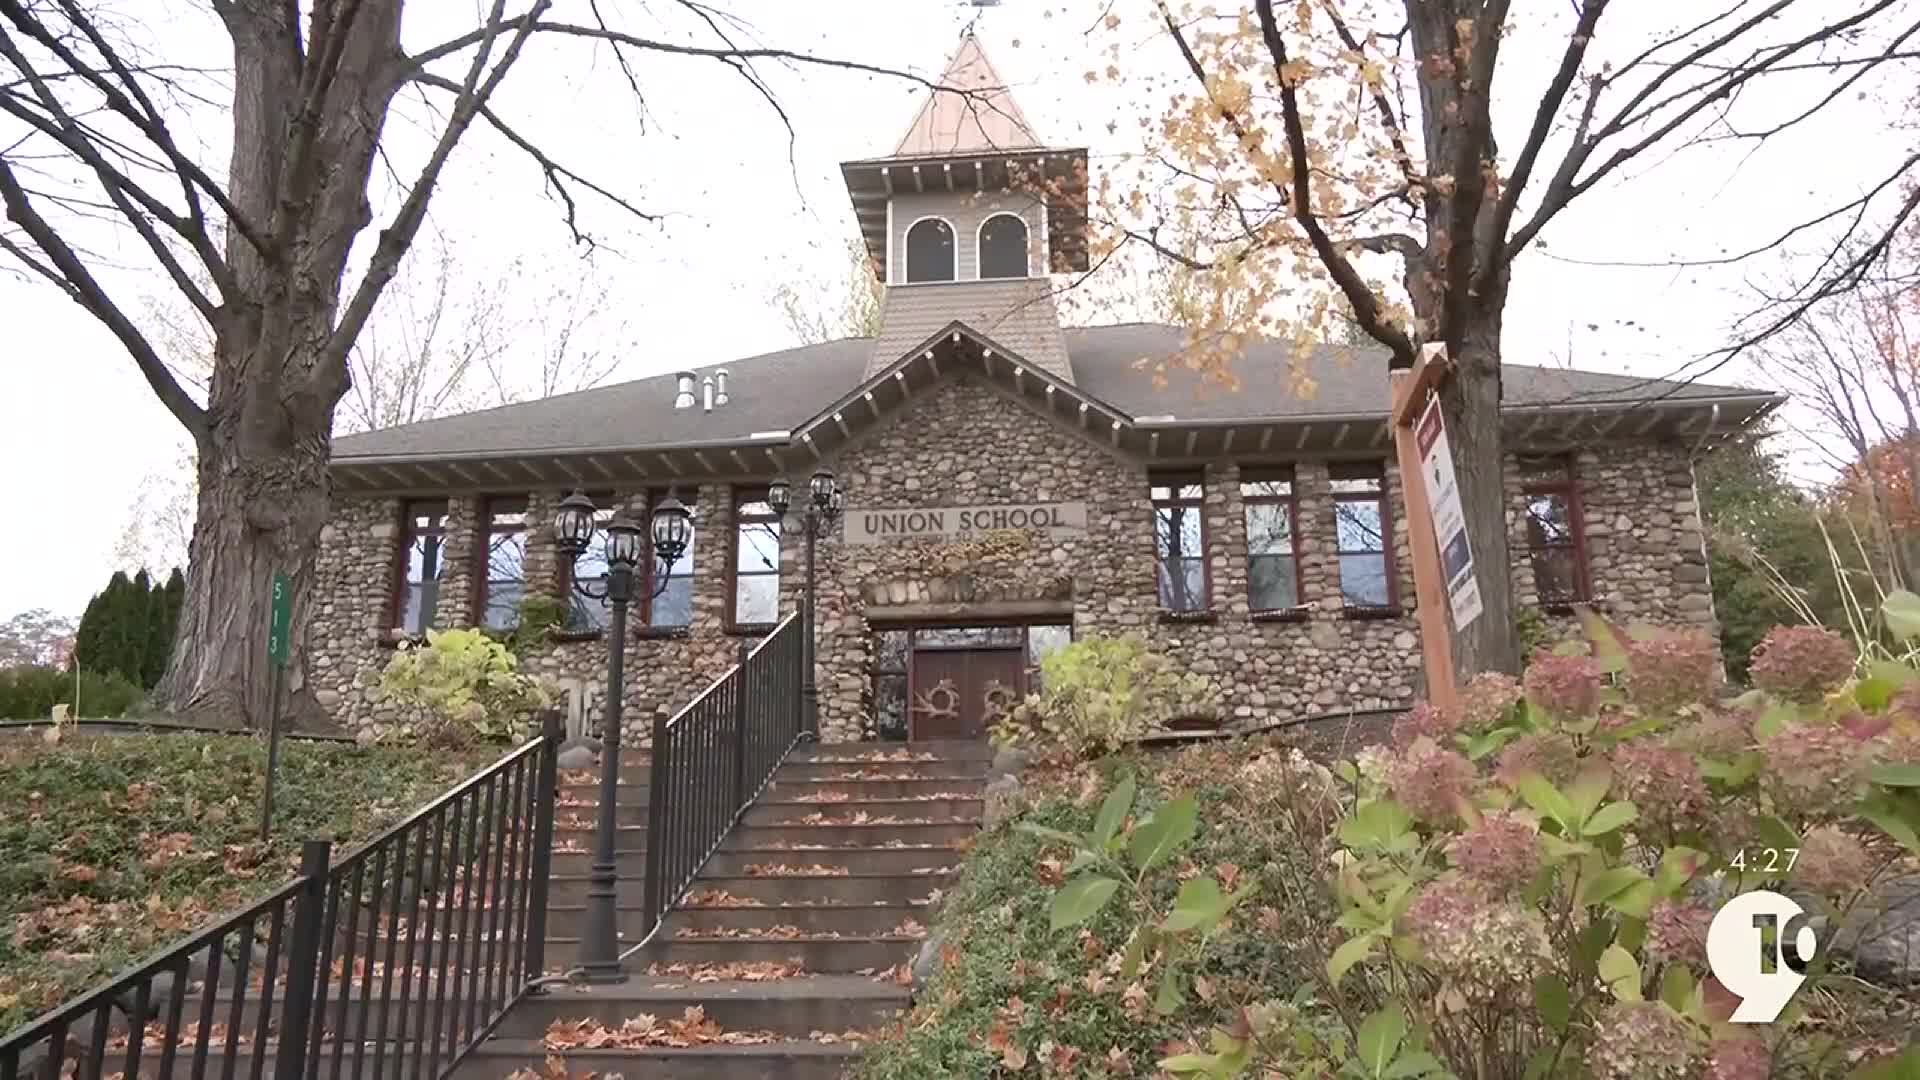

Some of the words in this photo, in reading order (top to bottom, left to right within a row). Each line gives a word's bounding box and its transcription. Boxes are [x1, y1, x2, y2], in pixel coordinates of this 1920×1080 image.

[864, 511, 944, 534] UNION
[958, 507, 1066, 530] SCHOOL
[270, 582, 282, 654] 513
